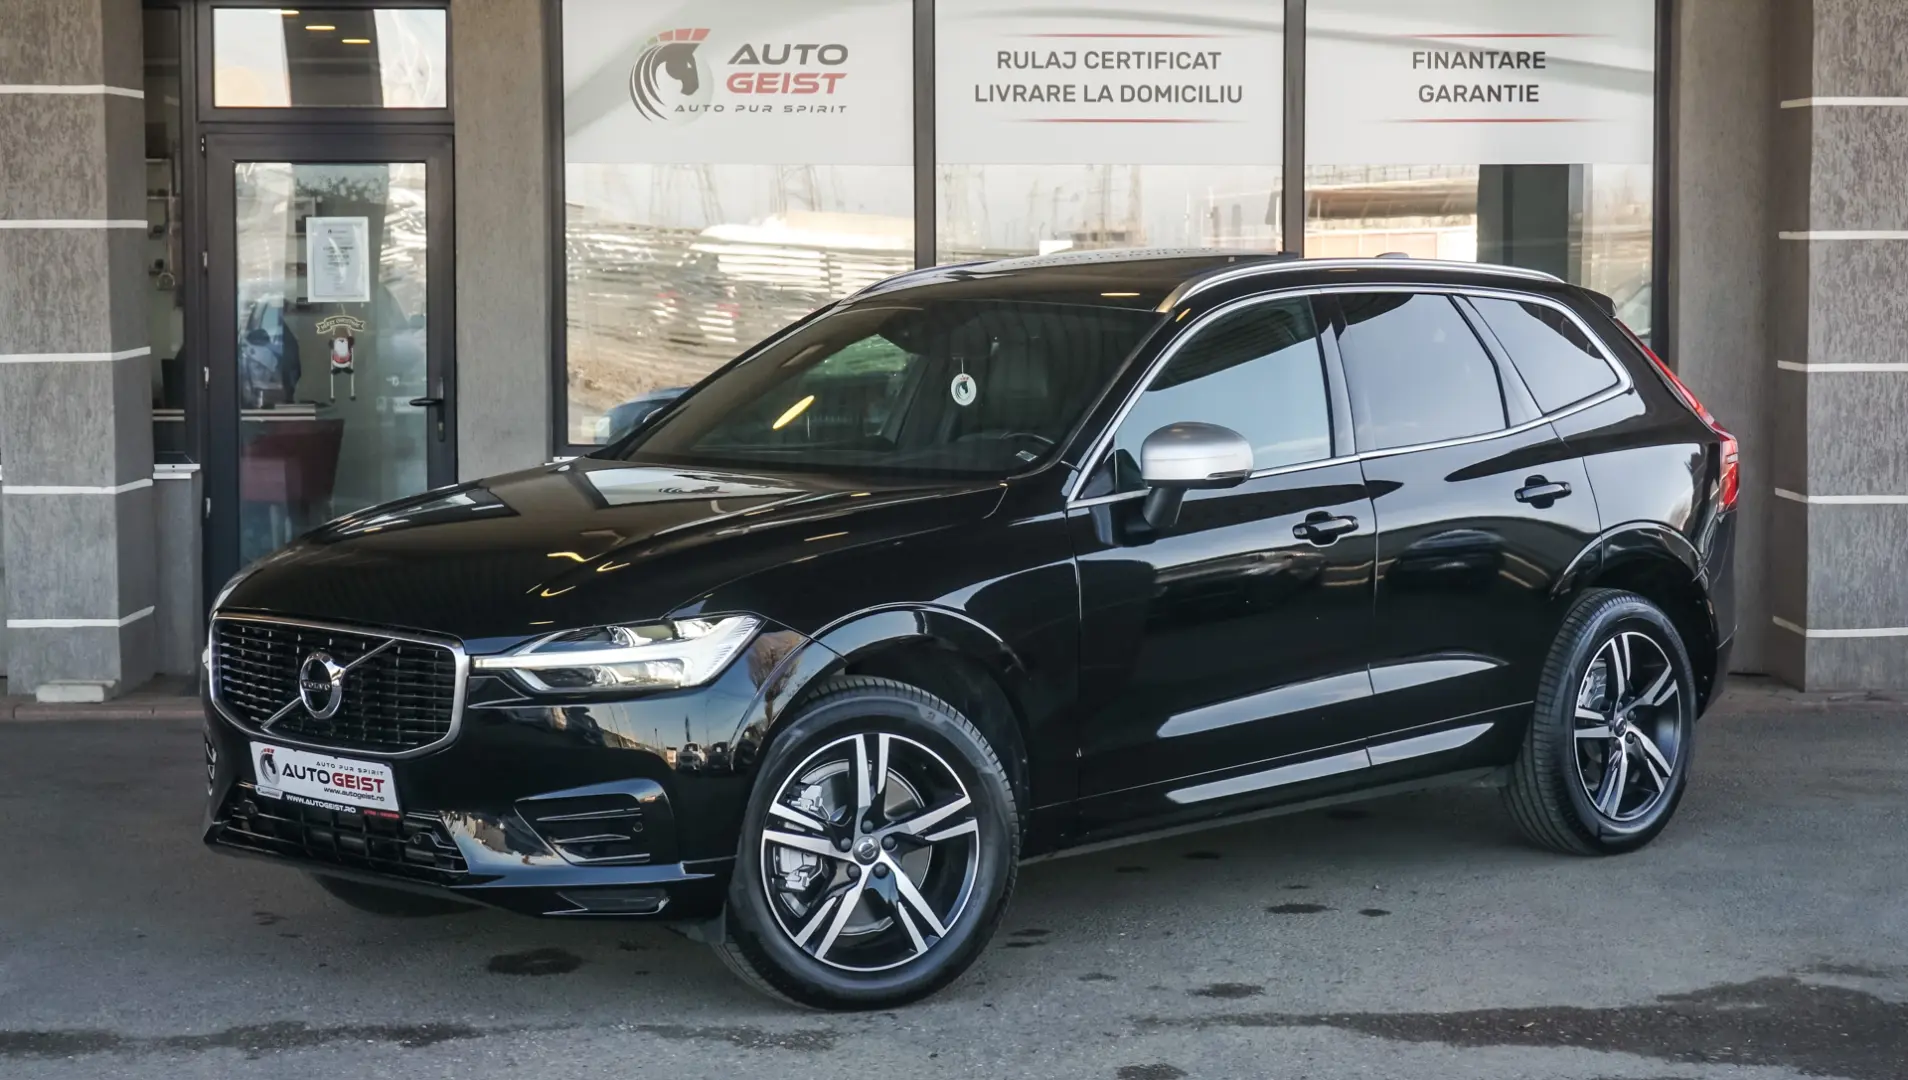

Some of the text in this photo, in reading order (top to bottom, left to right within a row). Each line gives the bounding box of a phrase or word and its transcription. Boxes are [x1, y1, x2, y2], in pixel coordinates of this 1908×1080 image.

[727, 43, 849, 66] AUTO
[997, 50, 1222, 70] RULAJ CERTIFICAT
[1412, 50, 1547, 70] FINANTARE
[726, 72, 848, 95] GEIST
[974, 83, 1243, 104] LIVRARE LA DOMICILIU
[1418, 83, 1540, 103] GARANTIE
[674, 104, 847, 113] AUTO PUR SPIRIT
[303, 681, 331, 691] VOLVO
[316, 761, 336, 769] AUTO
[357, 767, 385, 776] SPIRIT
[285, 794, 357, 814] WWW.AUTOGEIST.RO
[323, 786, 385, 802] www.autogeist.ro
